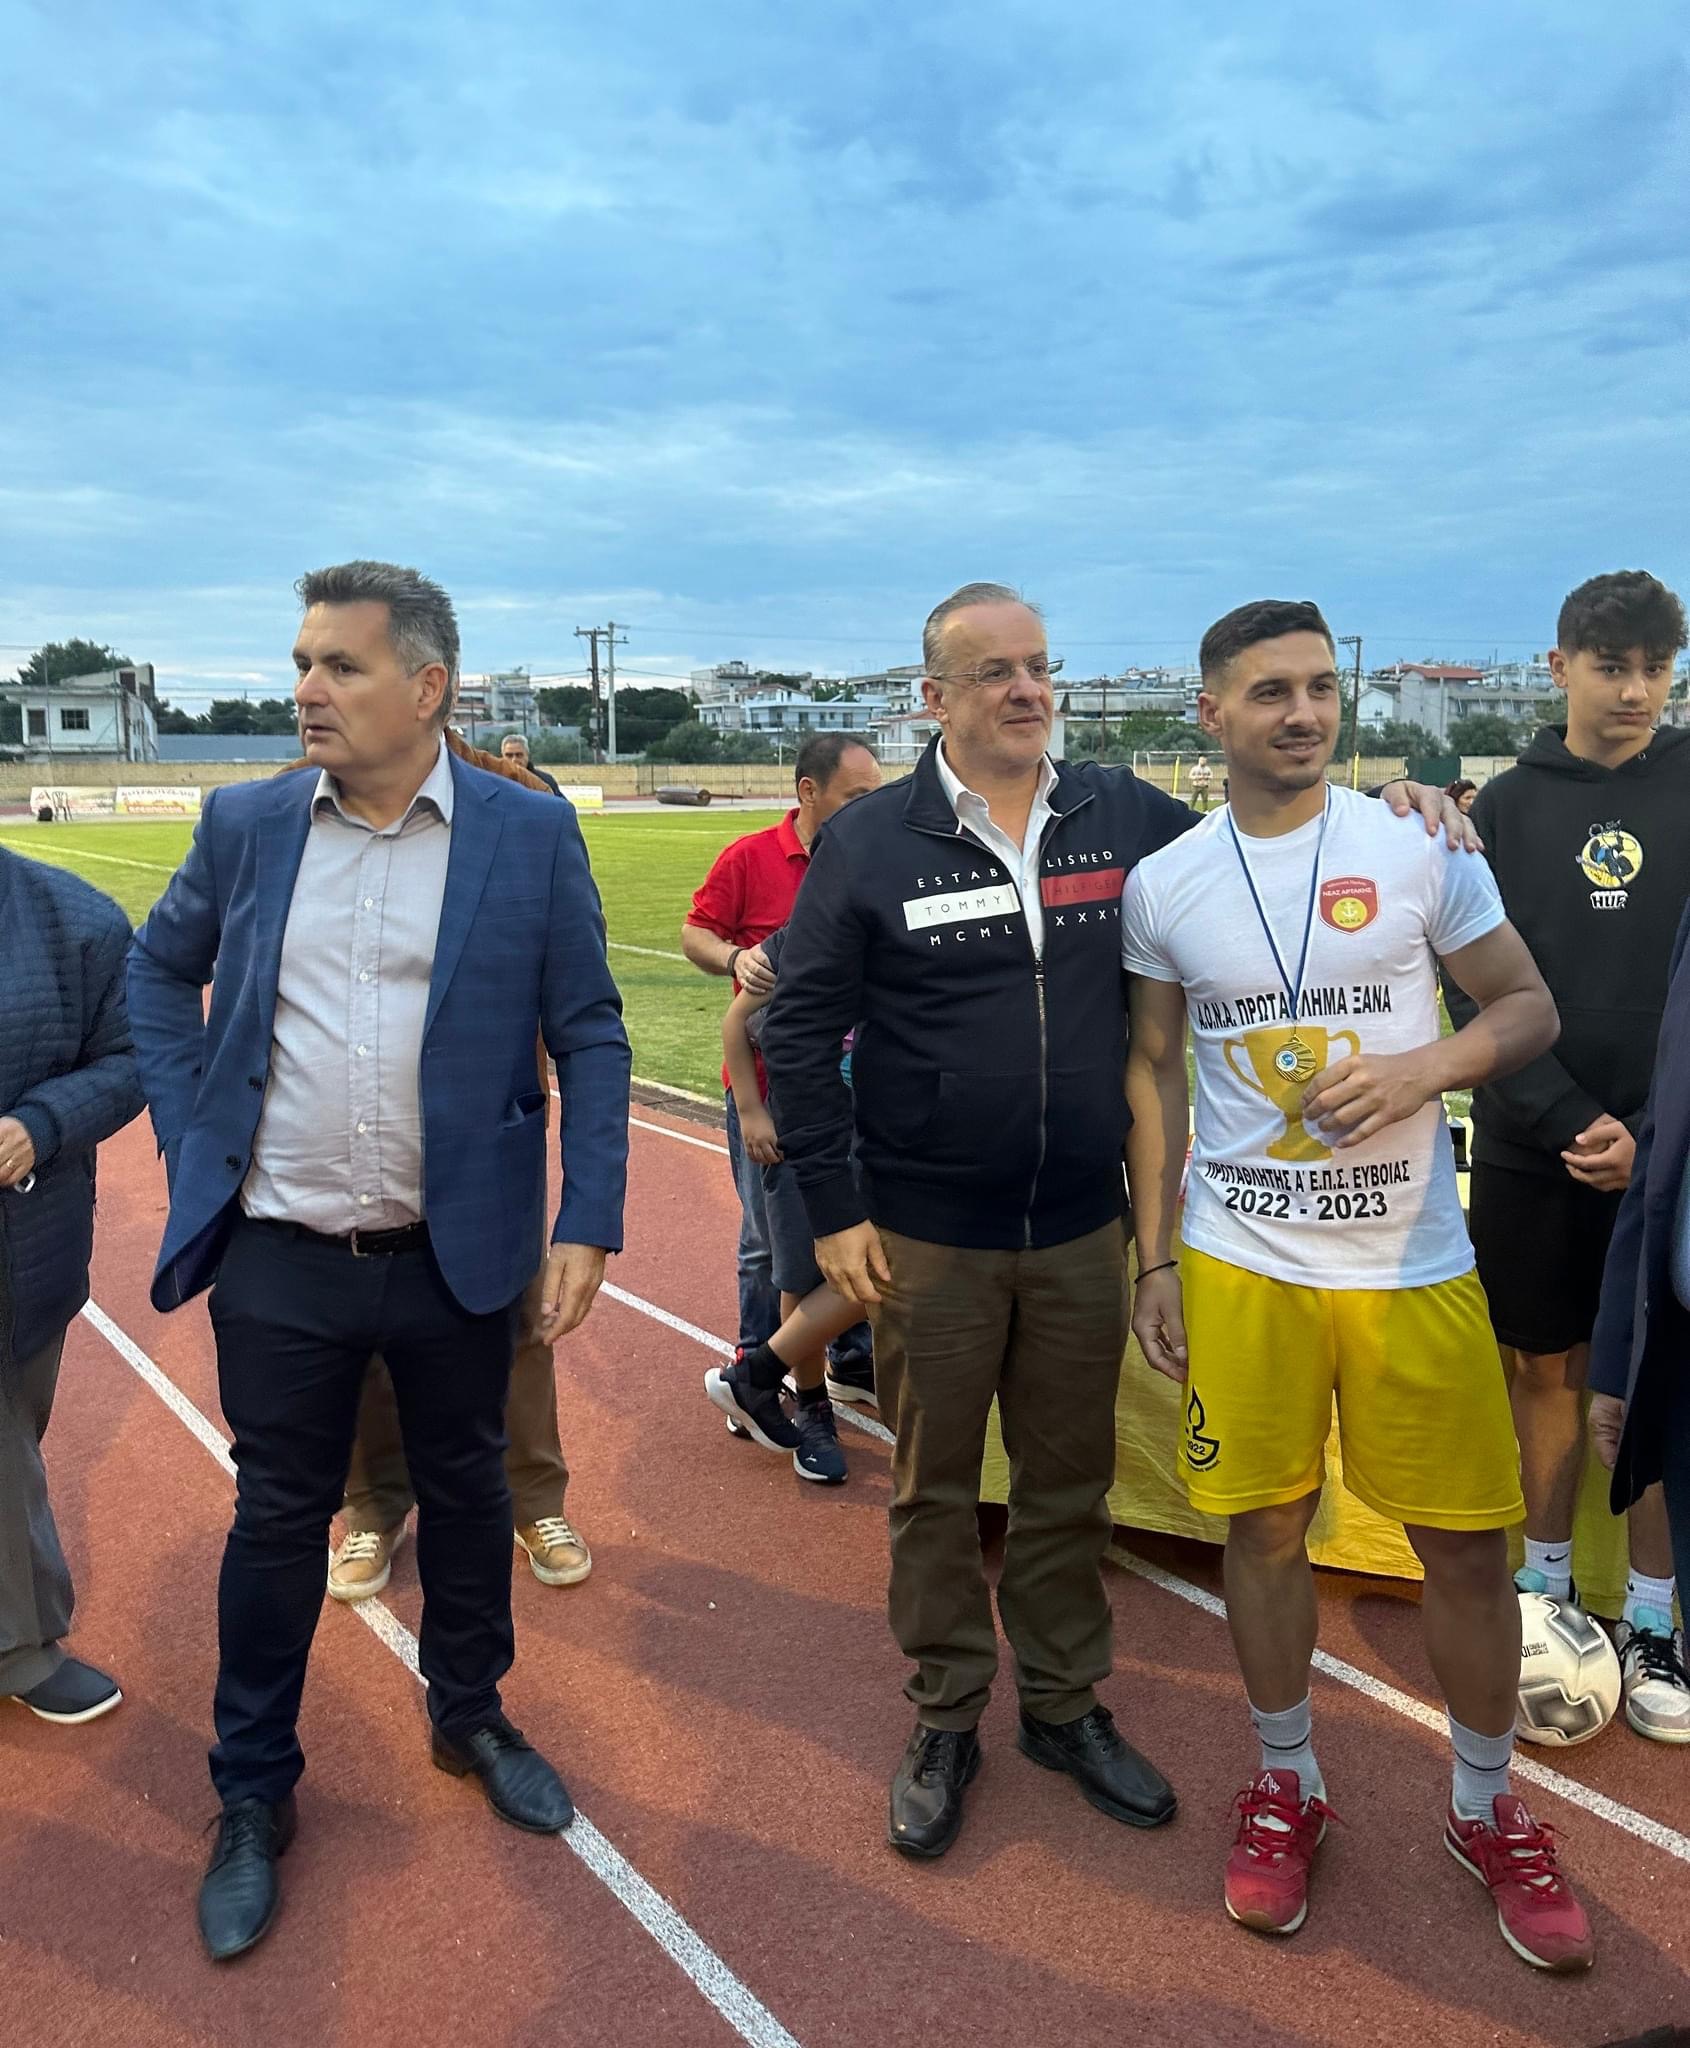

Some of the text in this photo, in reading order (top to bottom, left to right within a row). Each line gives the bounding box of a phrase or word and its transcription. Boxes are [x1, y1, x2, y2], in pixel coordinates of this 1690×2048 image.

[917, 850, 1113, 888] ESTAB LISHED
[924, 895, 1001, 916] TOMMY
[930, 924, 1013, 946] MCML
[1235, 987, 1348, 1026] ΠΡΩΤΑΛΗΜΑ
[1353, 985, 1391, 1014] ΞΑΝΑ
[1204, 1161, 1291, 1191] ΠΡΩΤΑΘΛΗΤΗΣ
[1310, 1168, 1349, 1190] Ε.Π.Σ.
[1353, 1160, 1410, 1188] ΕΥΒΟΙΑΣ
[1225, 1187, 1289, 1219] 2022
[1317, 1191, 1387, 1220] 2023
